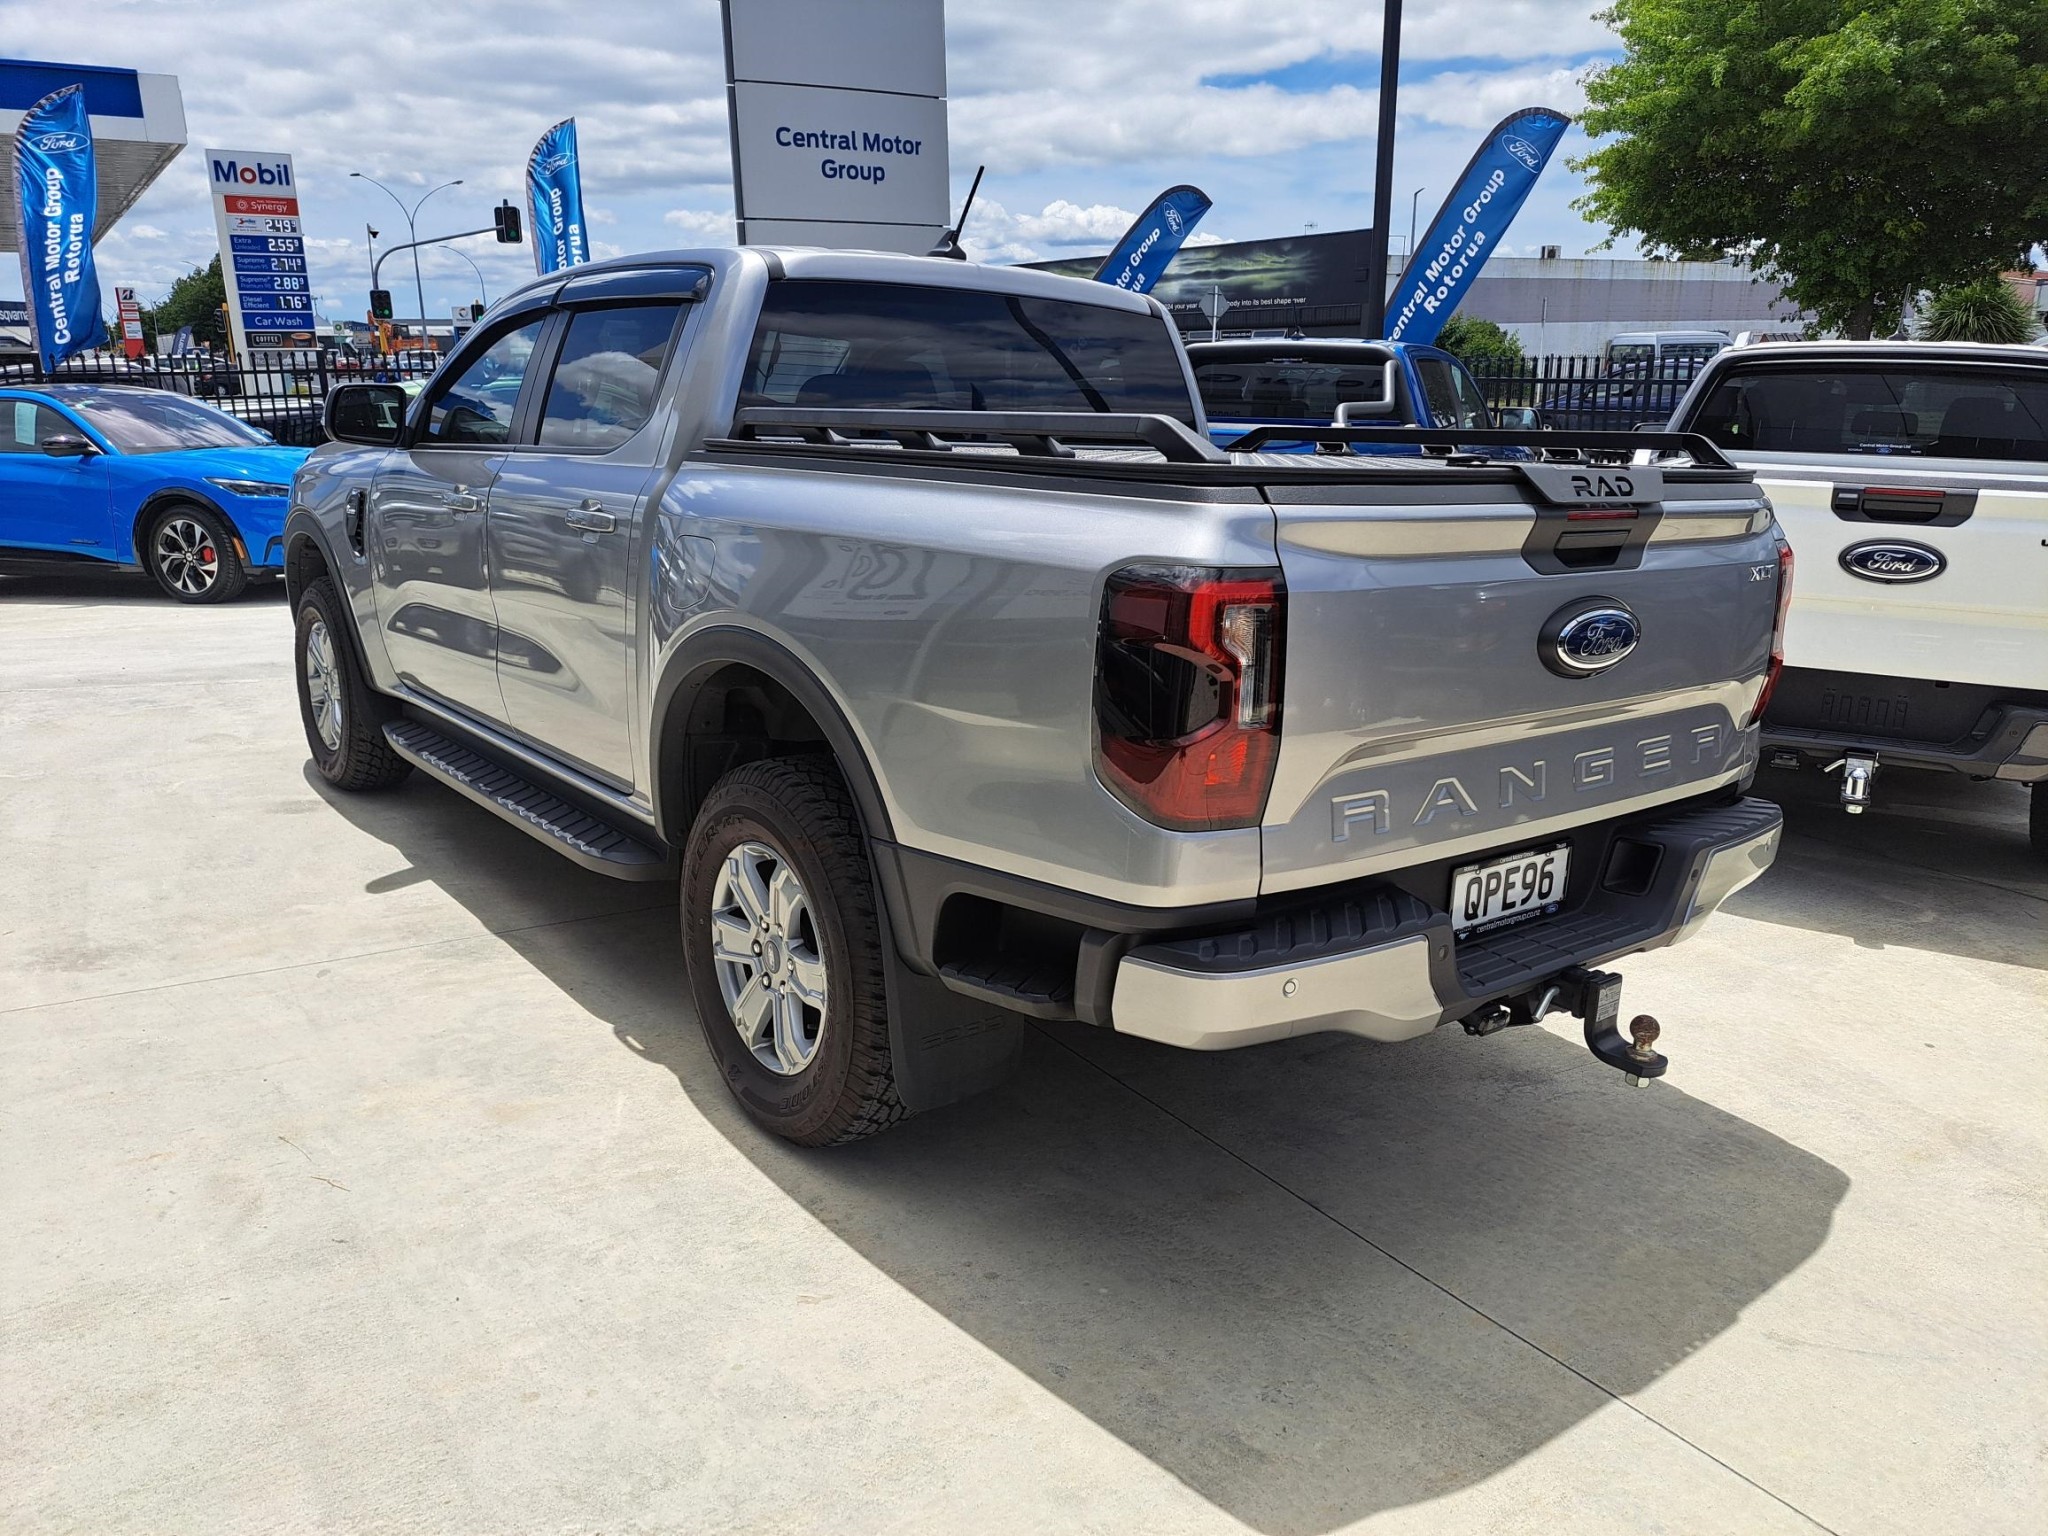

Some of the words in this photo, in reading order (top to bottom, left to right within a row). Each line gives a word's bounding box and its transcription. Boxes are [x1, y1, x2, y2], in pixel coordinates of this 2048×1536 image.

[40, 134, 77, 150] Ford
[776, 126, 857, 151] Central
[863, 132, 922, 155] Motor
[1509, 139, 1539, 167] Ford
[213, 160, 290, 186] Mobil
[546, 156, 568, 175] Ford
[821, 159, 885, 185] Group
[44, 168, 64, 217] Group
[251, 201, 288, 213] Synergy
[551, 187, 564, 236] Group
[1166, 209, 1181, 232] Ford
[44, 220, 61, 272] Motor
[64, 213, 84, 284] Rotorua
[237, 256, 265, 264] Supreme
[1115, 266, 1132, 289] tor
[1130, 228, 1160, 267] Group
[1388, 281, 1429, 341] entral
[1425, 225, 1467, 283] Motor
[1463, 169, 1505, 224] Group
[1423, 230, 1486, 315] Rotorua
[46, 273, 72, 345] Central
[1274, 297, 1292, 305] shape
[254, 316, 272, 326] Car
[274, 316, 303, 326] Wash
[1571, 475, 1634, 497] RAD
[1749, 563, 1776, 582] XLT
[1866, 551, 1918, 573] Ford
[1580, 622, 1625, 657] Ford
[1331, 722, 1722, 843] RANGER
[1464, 857, 1555, 921] QPE96
